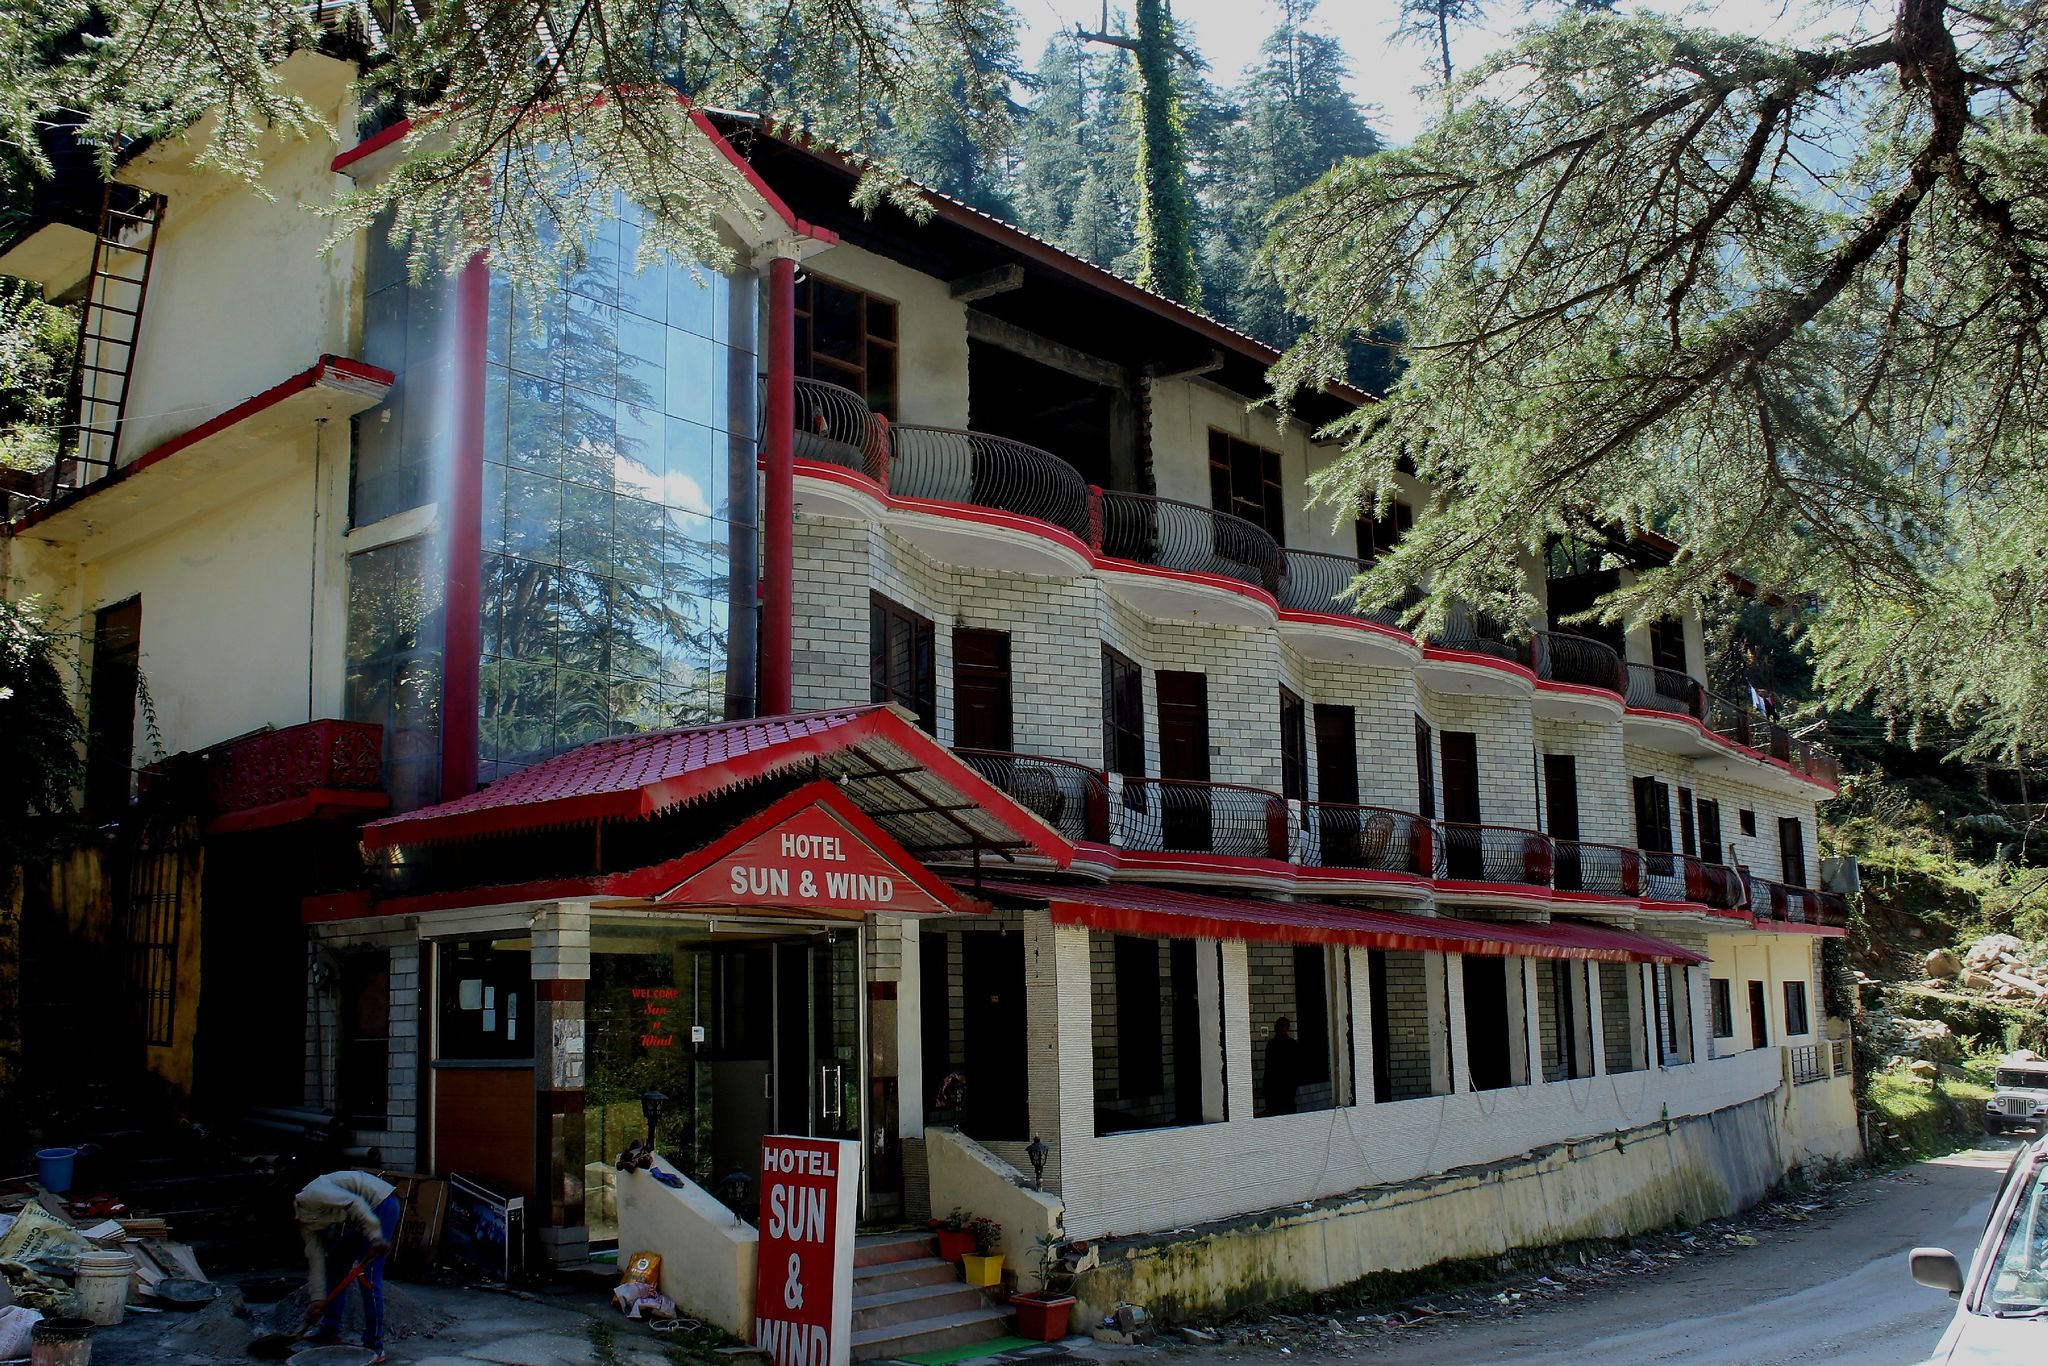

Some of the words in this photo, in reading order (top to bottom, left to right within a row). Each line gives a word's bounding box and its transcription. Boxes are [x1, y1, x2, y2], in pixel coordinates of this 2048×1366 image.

[781, 833, 846, 861] HOTEL
[730, 866, 789, 897] SUN
[799, 870, 818, 898] &
[826, 872, 894, 902] WIND
[631, 988, 680, 1000] WELCOME
[643, 1002, 668, 1016] Sun
[640, 1033, 673, 1049] Wind
[763, 1147, 836, 1177] HOTEL
[769, 1183, 827, 1244] SUN
[784, 1252, 803, 1310] &
[756, 1317, 828, 1366] WIND
